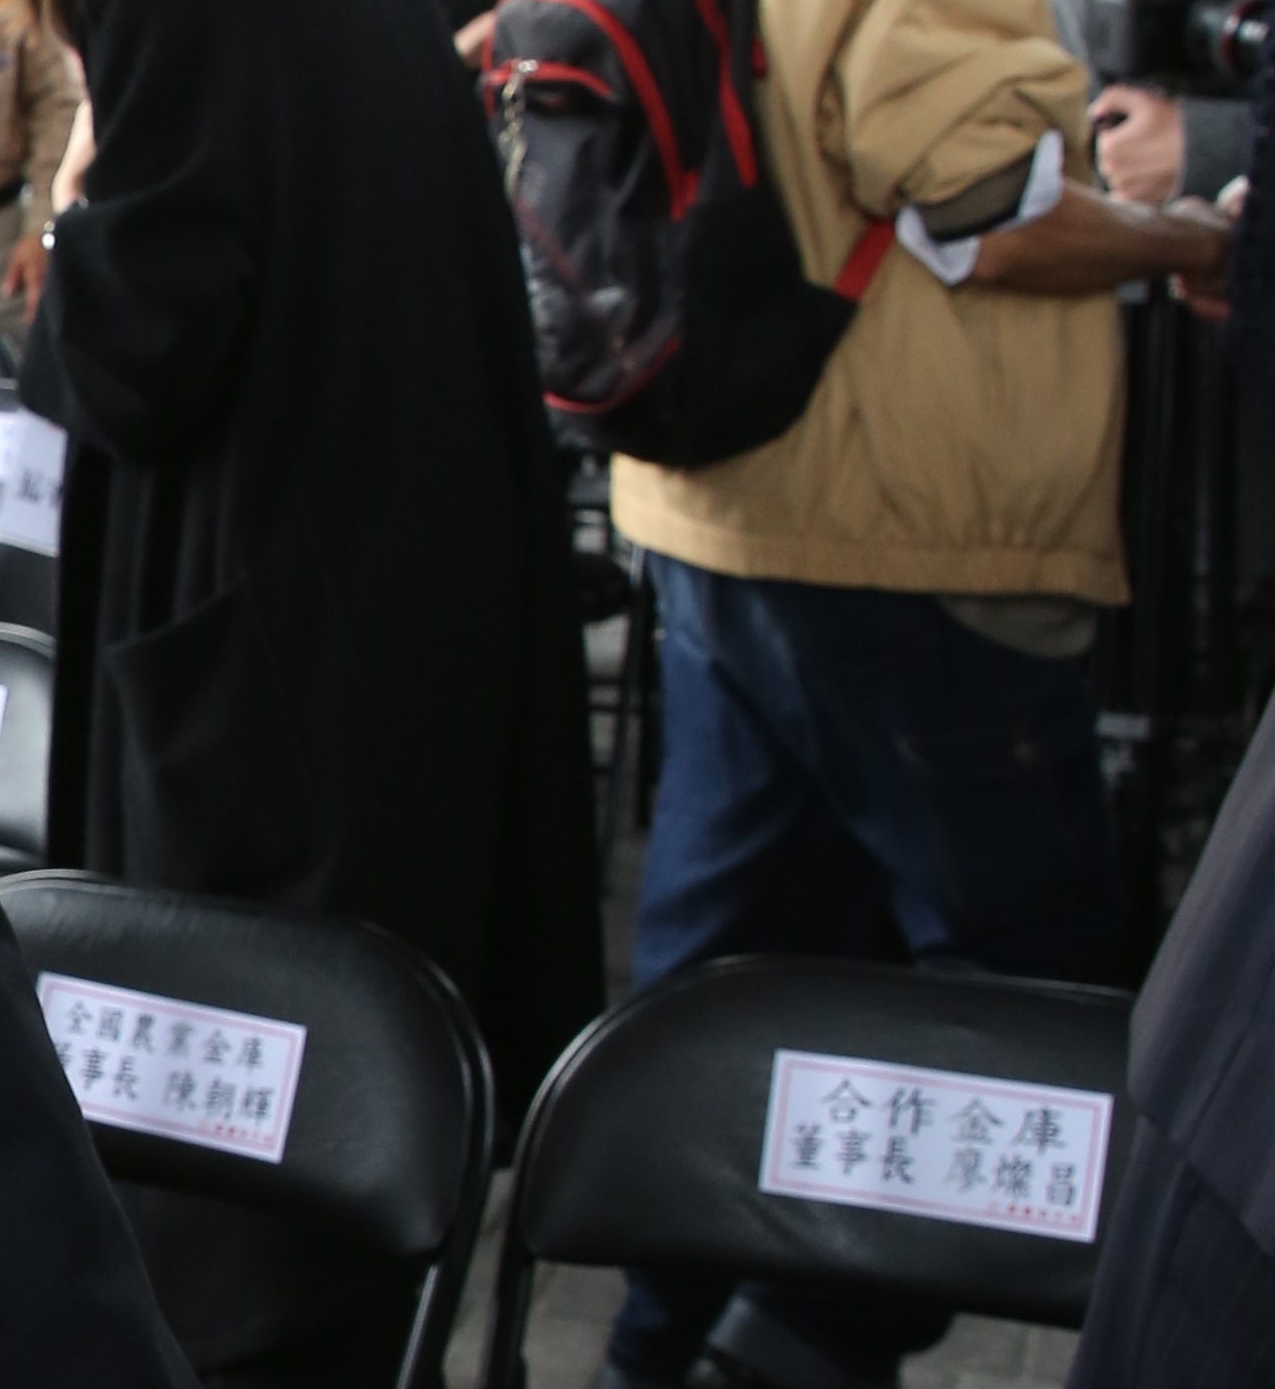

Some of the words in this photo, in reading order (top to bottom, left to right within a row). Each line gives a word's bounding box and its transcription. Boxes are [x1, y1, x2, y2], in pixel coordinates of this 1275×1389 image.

[67, 999, 263, 1071] 全國農業金庫
[792, 1122, 915, 1184] 董事長
[821, 1079, 1066, 1155] 合作金庫
